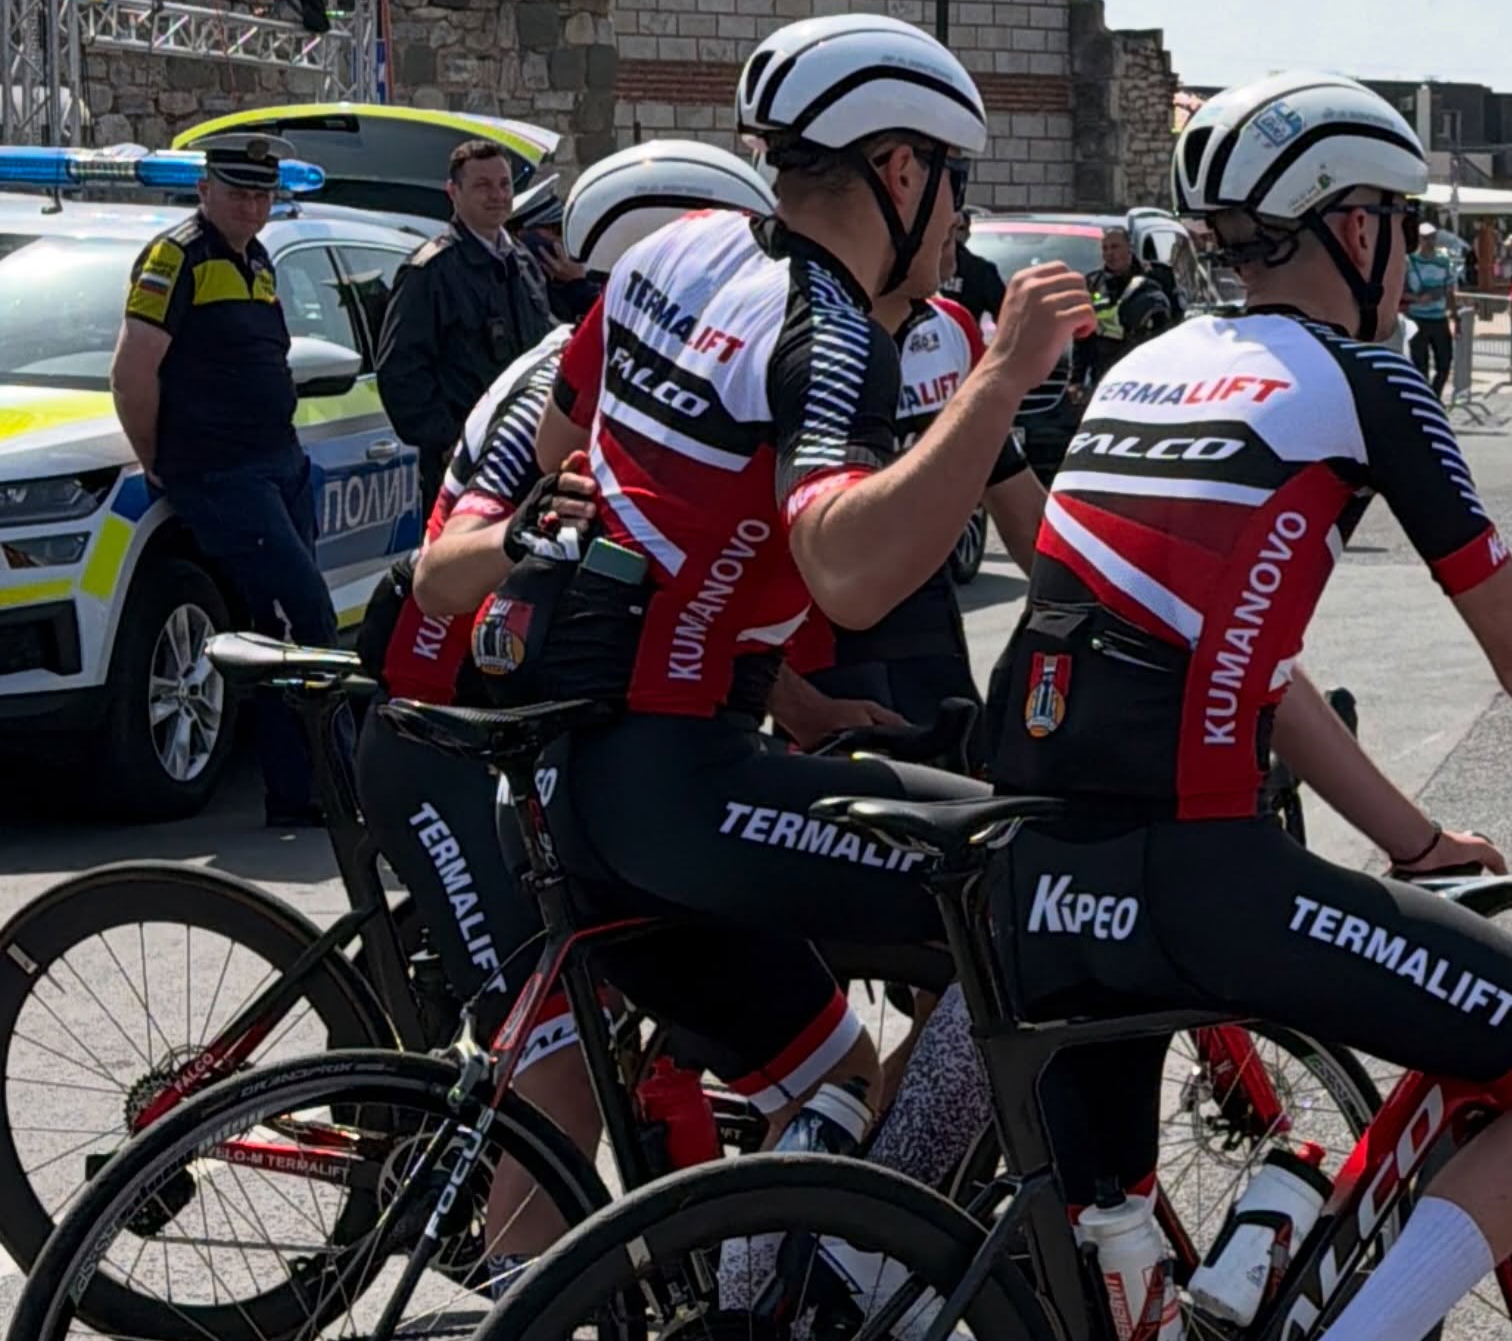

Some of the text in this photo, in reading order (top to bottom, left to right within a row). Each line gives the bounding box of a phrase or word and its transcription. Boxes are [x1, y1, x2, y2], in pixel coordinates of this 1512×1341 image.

[623, 270, 745, 364] TERMAIFT
[609, 346, 711, 418] FALCO
[897, 371, 959, 412] ALIFT
[1099, 376, 1294, 406] ERMALIFT
[323, 462, 418, 533] ПОЛИЦ
[668, 519, 770, 683] KUMANOVO
[1204, 511, 1307, 746] KUMANOVO
[719, 801, 925, 872] TERMALIF
[409, 802, 507, 993] TERMALIFT
[173, 1052, 214, 1093] FALCO
[267, 1152, 349, 1185] TERMALIFT
[426, 1106, 496, 1241] FOCUS
